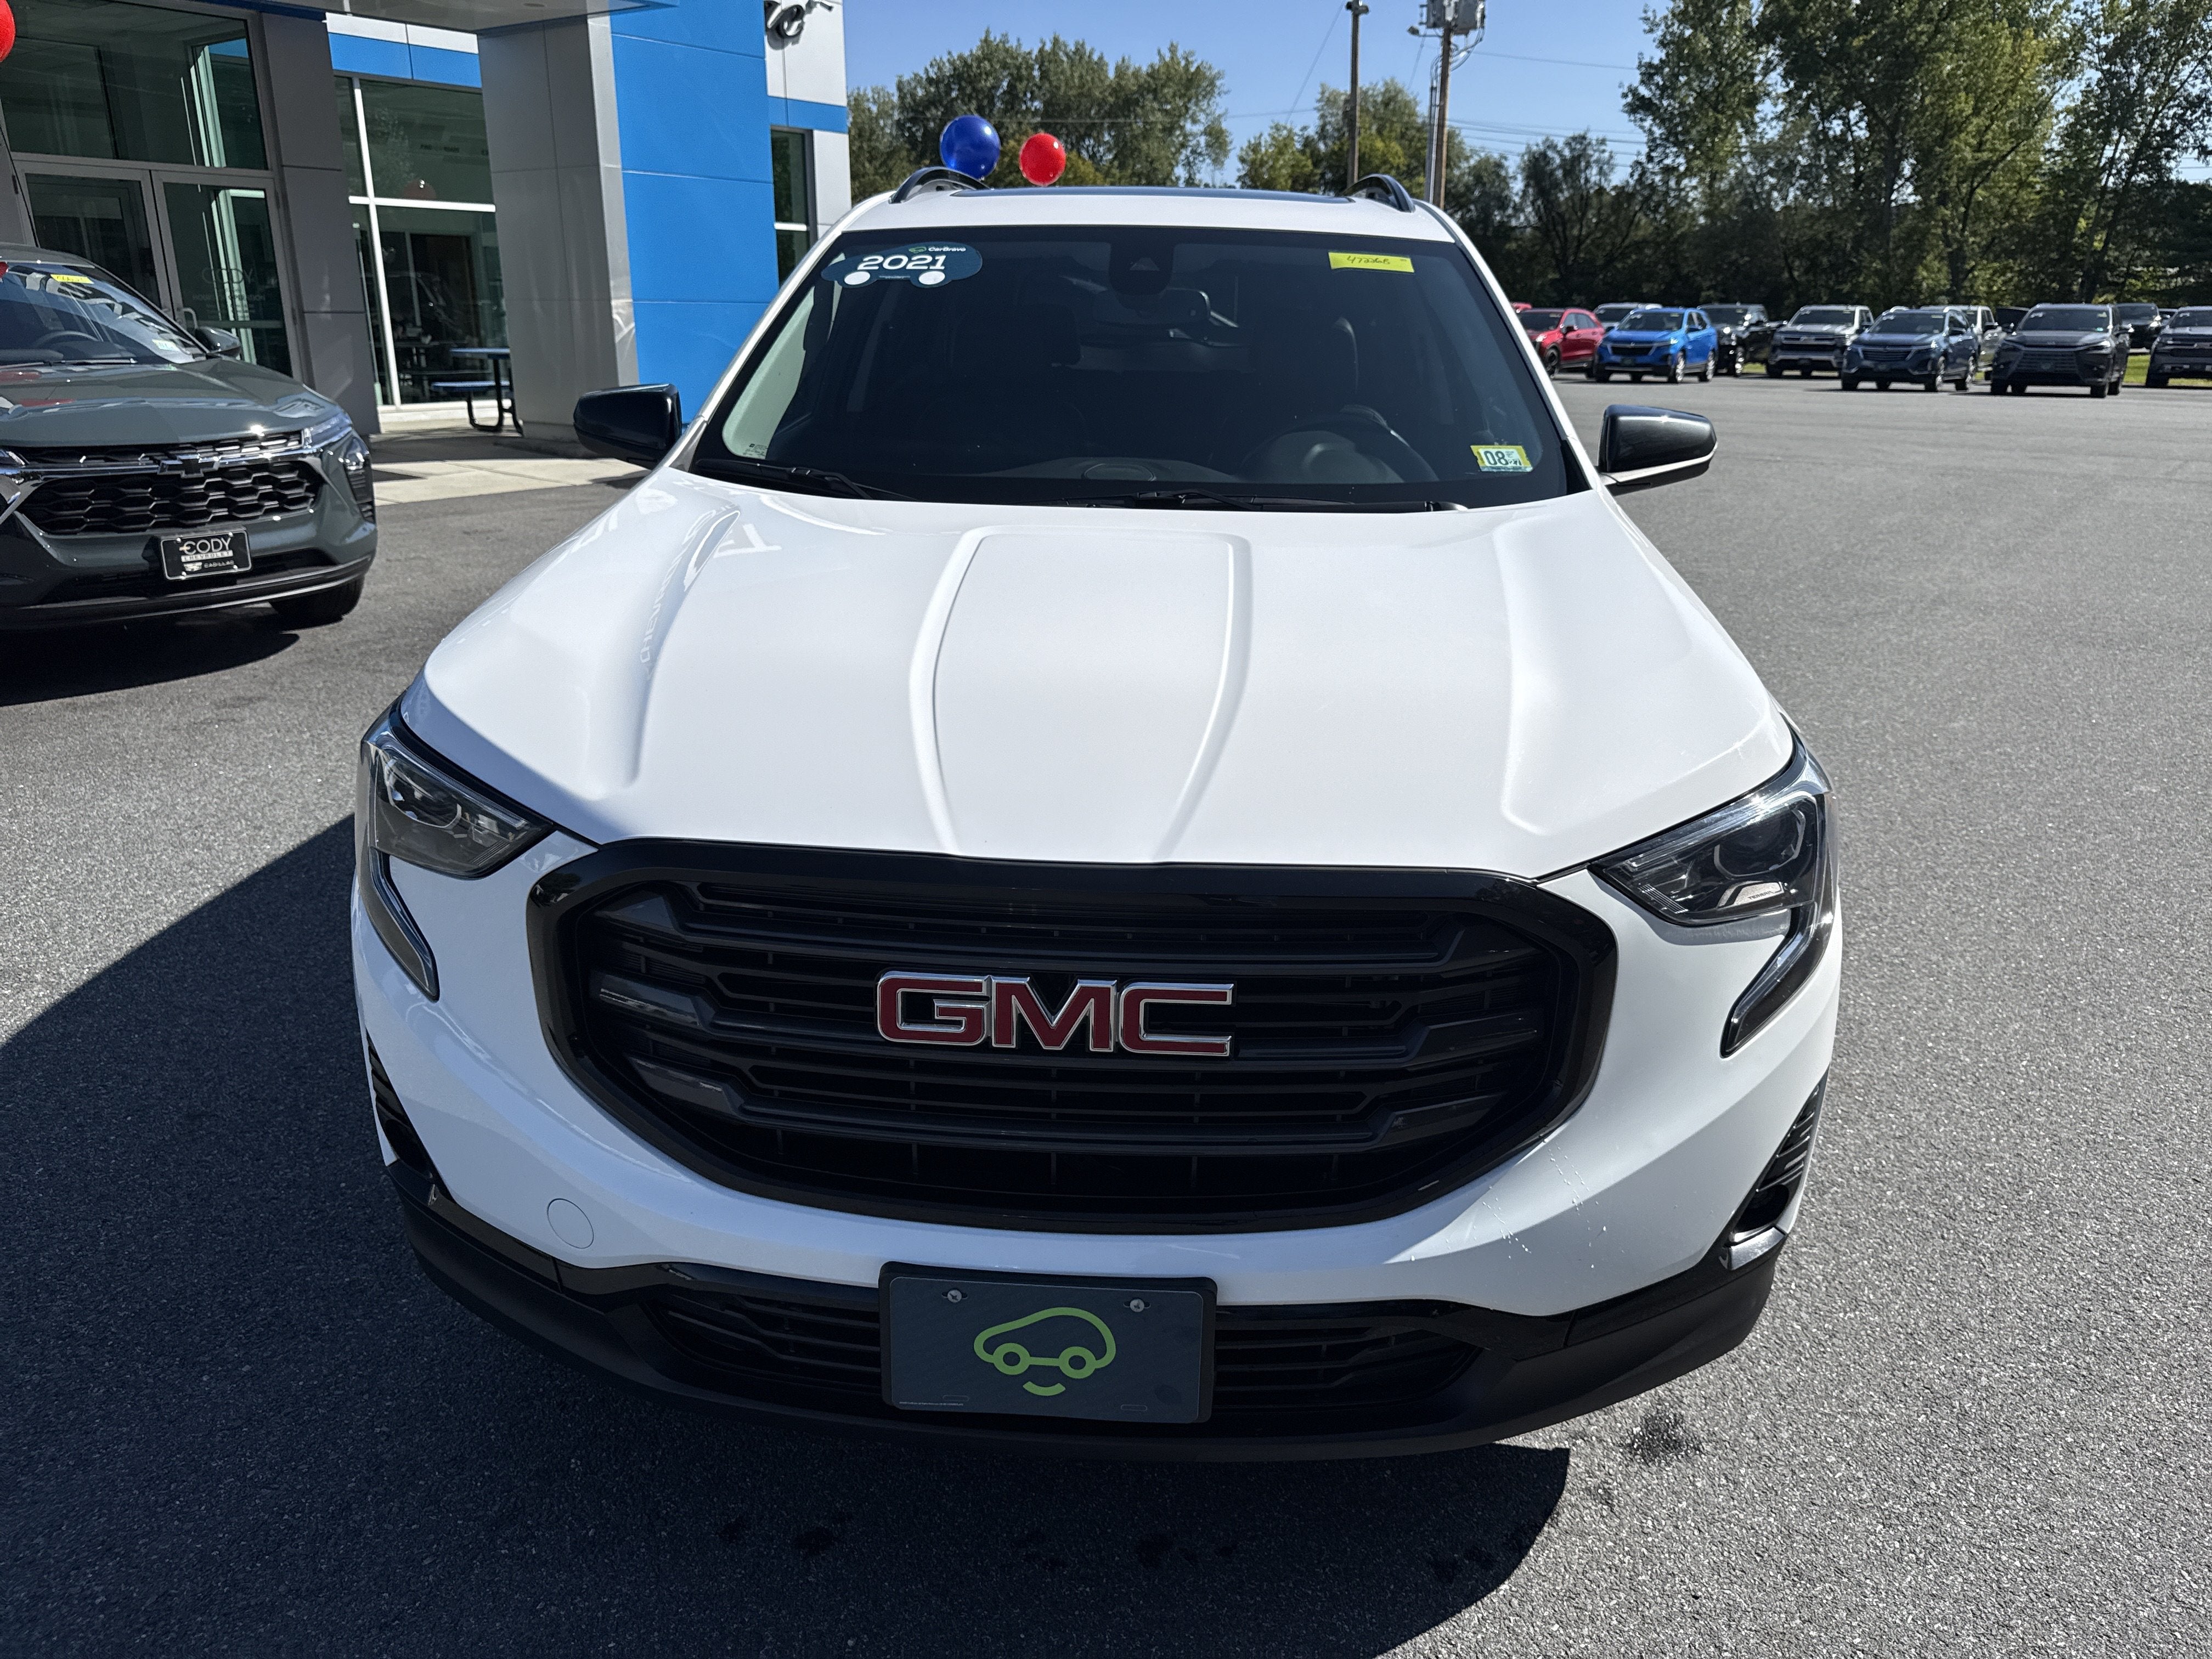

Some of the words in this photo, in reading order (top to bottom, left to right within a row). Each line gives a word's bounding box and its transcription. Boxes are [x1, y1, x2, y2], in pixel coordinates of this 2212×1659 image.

[857, 255, 946, 270] 2021
[1483, 450, 1509, 466] 08
[183, 537, 232, 555] CODY
[877, 970, 1234, 1057] GMC
